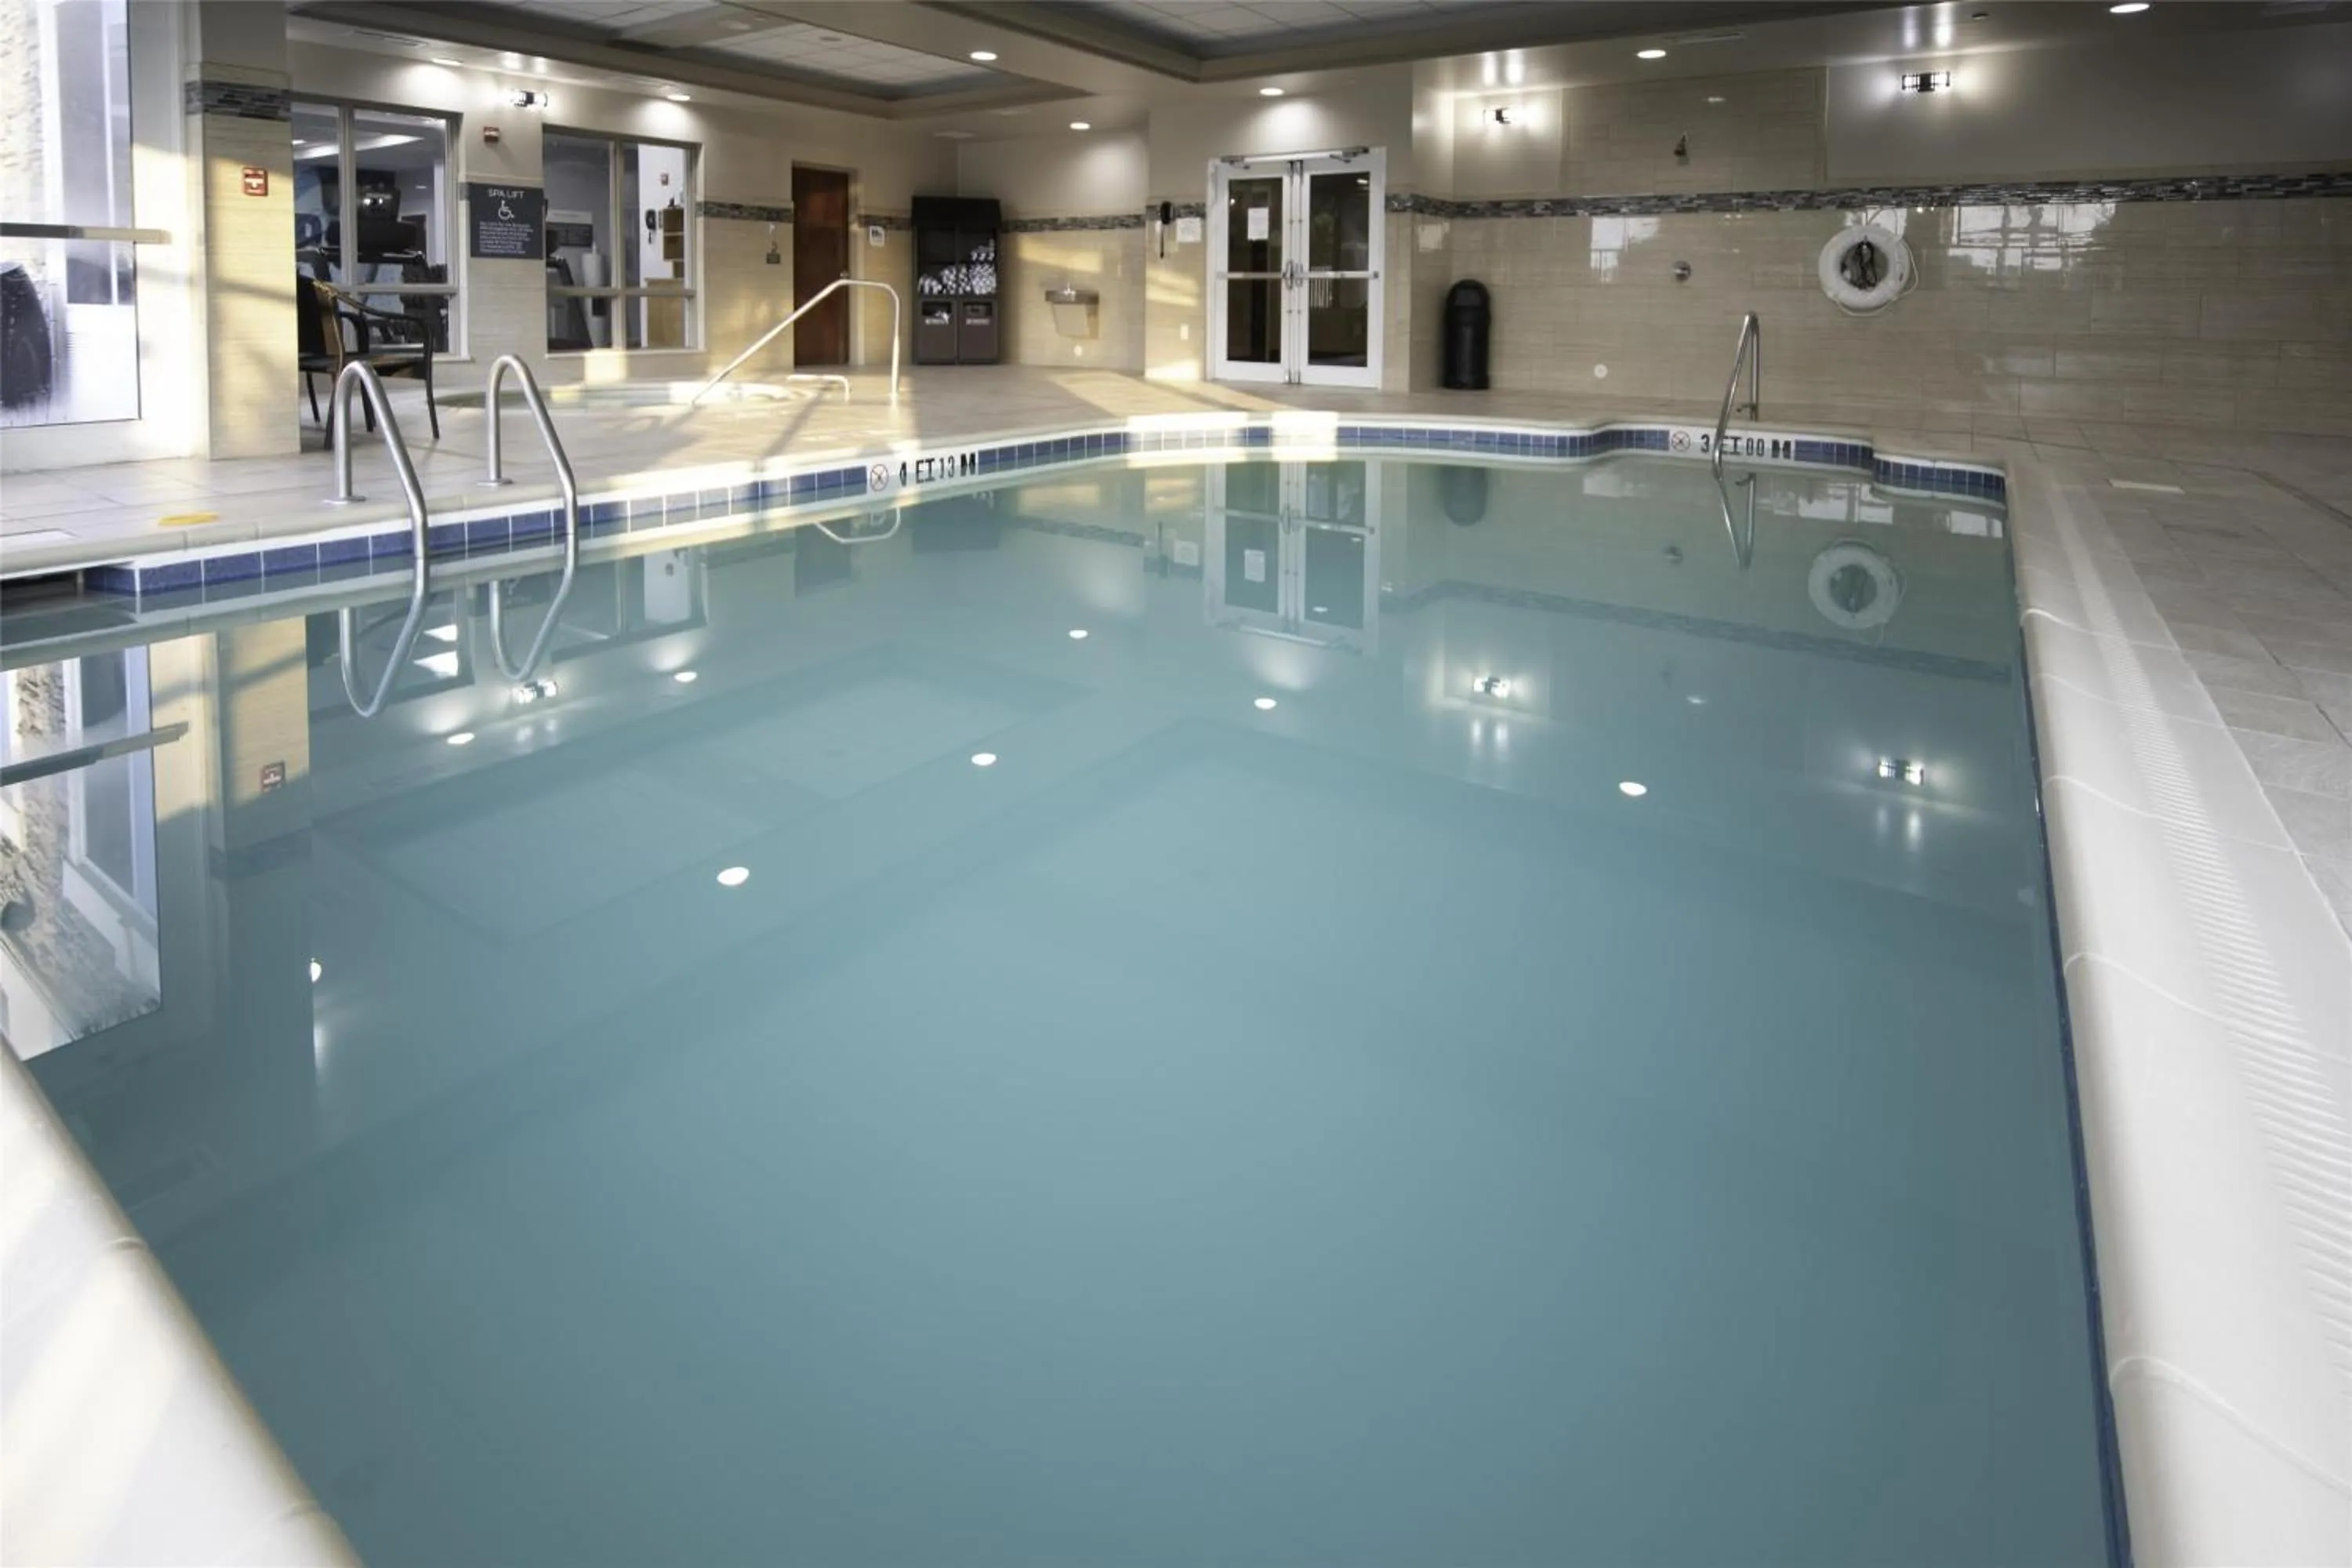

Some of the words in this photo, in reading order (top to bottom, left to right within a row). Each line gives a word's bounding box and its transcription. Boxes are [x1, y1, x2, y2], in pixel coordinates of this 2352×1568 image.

[488, 188, 506, 198] SPA
[1700, 434, 1710, 453] 3
[960, 452, 976, 477] M
